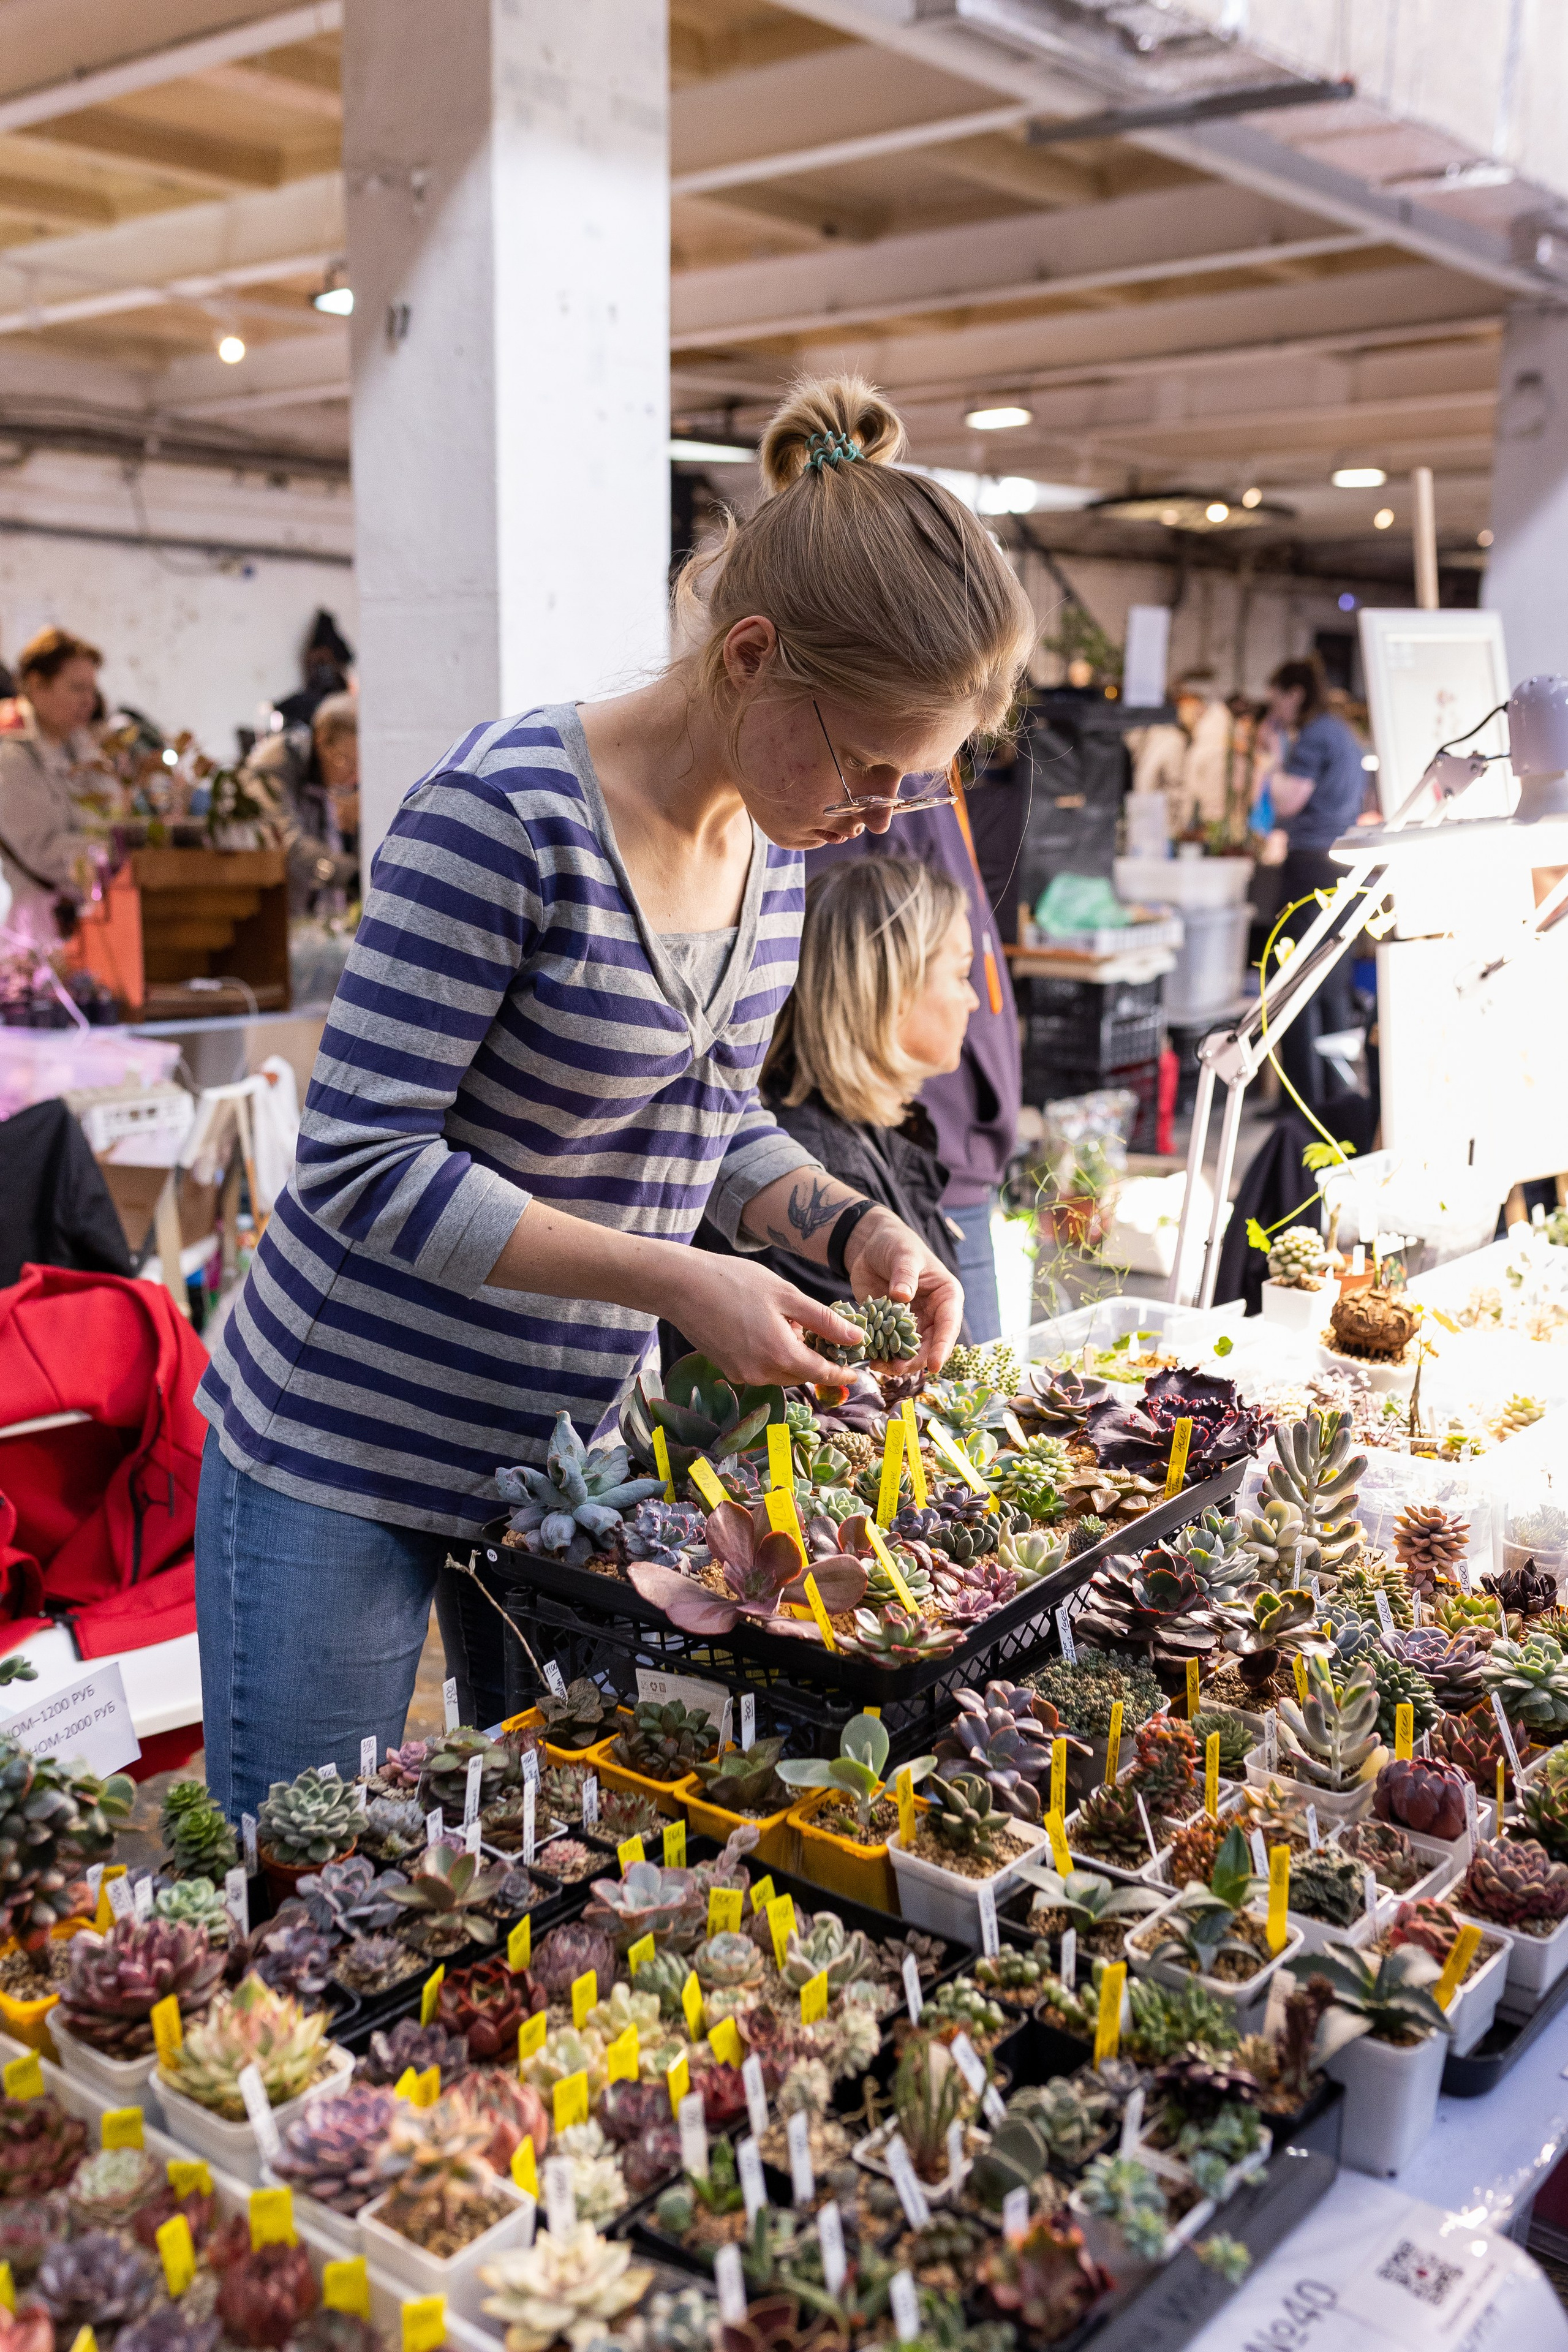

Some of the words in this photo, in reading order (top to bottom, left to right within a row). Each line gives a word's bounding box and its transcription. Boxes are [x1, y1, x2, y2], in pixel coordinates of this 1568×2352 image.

[888, 1429, 901, 1455] 600
[1175, 1423, 1187, 1452] 4000
[772, 1494, 785, 1523] 1200
[886, 1494, 896, 1519] DARK
[1459, 1566, 1469, 1593] 1500
[6, 1697, 70, 1740] ОМ–1200
[72, 1684, 96, 1706] РУБ
[94, 1700, 117, 1724] РУБ
